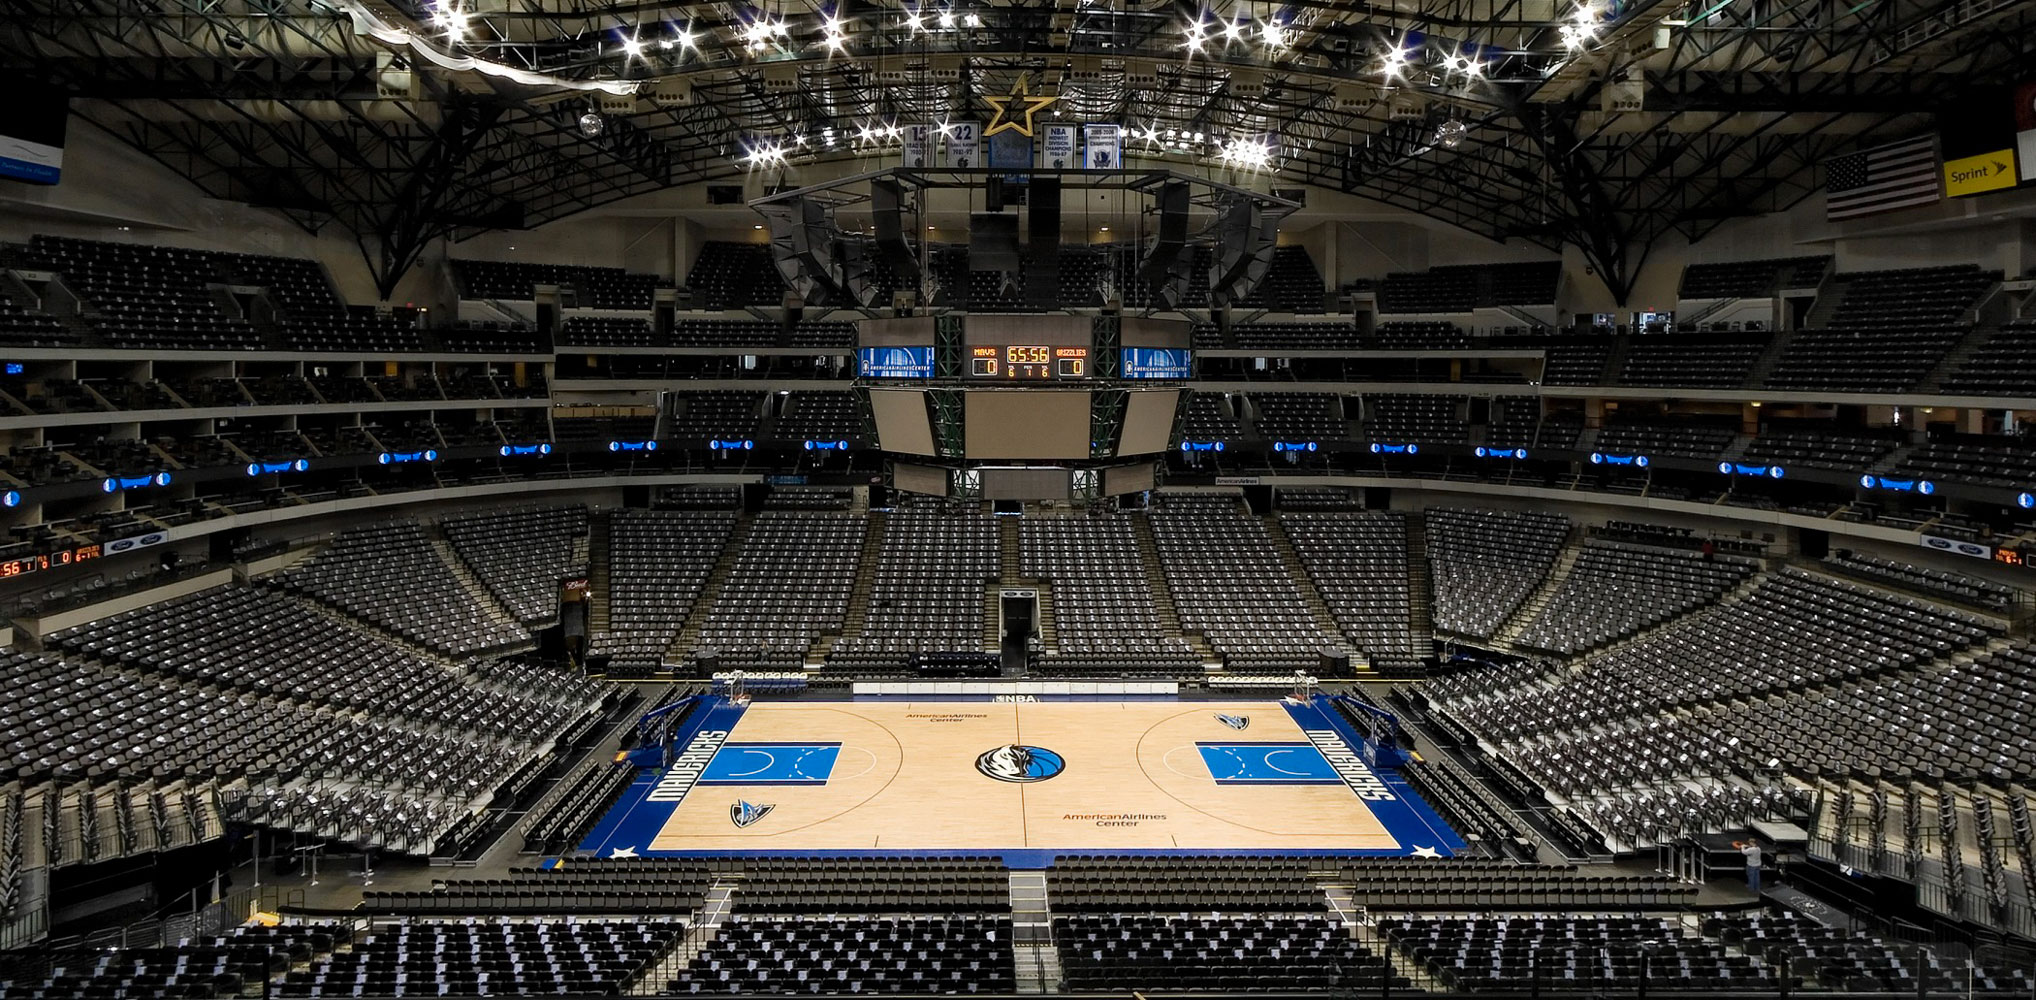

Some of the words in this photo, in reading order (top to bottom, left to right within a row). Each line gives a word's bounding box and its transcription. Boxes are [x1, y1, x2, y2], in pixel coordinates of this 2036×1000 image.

[912, 126, 927, 141] 15
[954, 125, 972, 140] 22
[1050, 127, 1067, 136] NBA
[1951, 166, 1988, 184] Sprint
[973, 348, 996, 356] MAVS
[1008, 347, 1048, 362] 65:56
[1056, 348, 1087, 357] GRIZZLIES
[987, 360, 996, 374] 0
[1008, 369, 1015, 378] 6
[1042, 369, 1048, 378] 6
[1073, 360, 1082, 374] 0
[62, 552, 70, 563] 0
[646, 730, 728, 801] MAVERICKS
[1305, 730, 1396, 801] MAVERICKS
